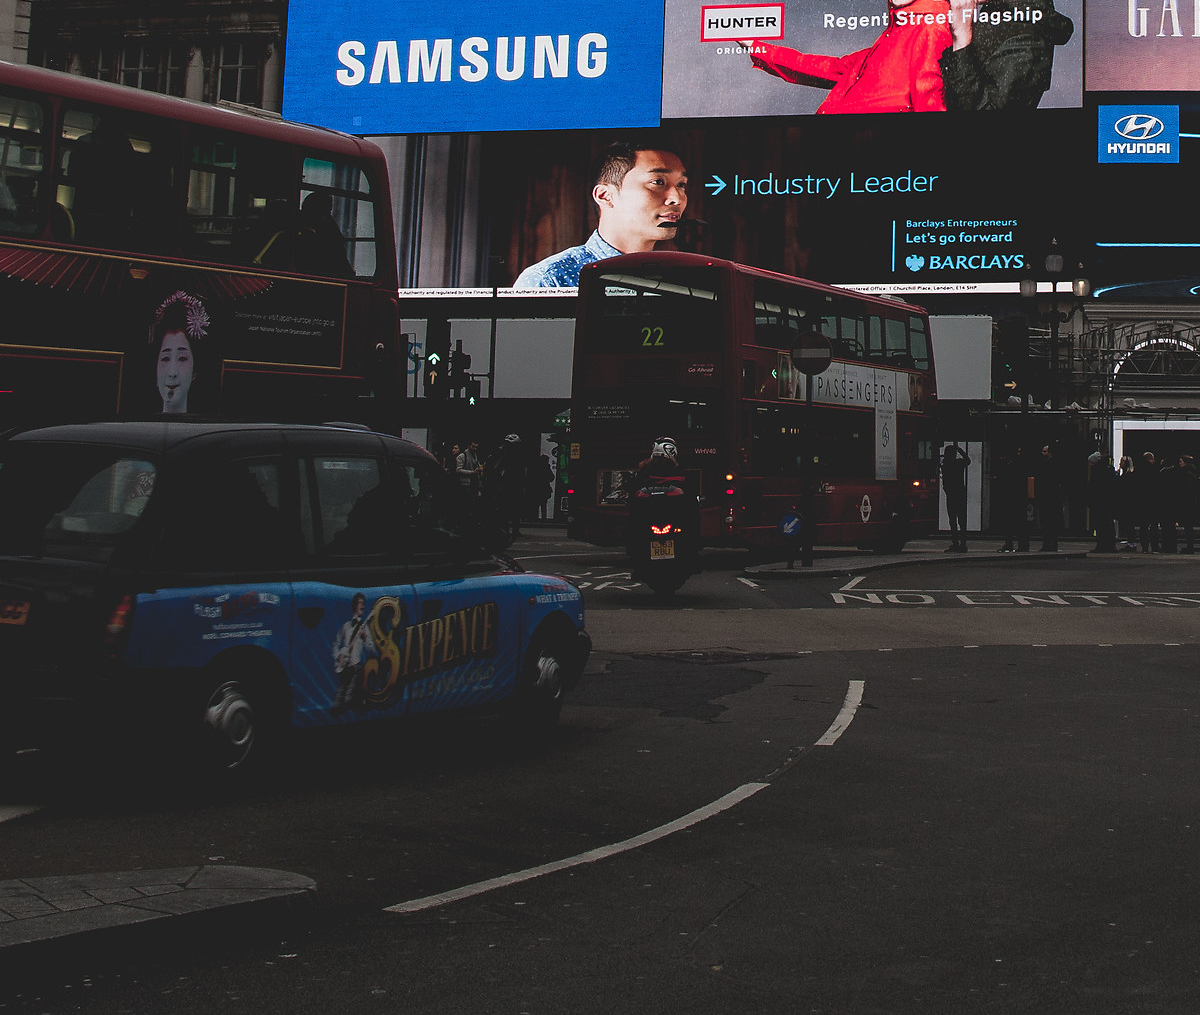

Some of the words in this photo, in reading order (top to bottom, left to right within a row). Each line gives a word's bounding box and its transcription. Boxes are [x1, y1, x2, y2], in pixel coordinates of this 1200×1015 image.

[707, 16, 778, 30] HUNTER
[823, 12, 890, 31] Regent
[895, 9, 954, 27] Street
[961, 6, 1043, 28] Flagship
[716, 46, 768, 56] ORIGINAL
[335, 32, 608, 87] SAMSUNG
[1107, 142, 1171, 154] HYUNDAI
[733, 172, 841, 199] Industry
[849, 169, 939, 194] Leader
[905, 219, 945, 229] Barclays
[946, 218, 1018, 229] Entrepreneurs
[905, 232, 937, 245] Let's
[938, 233, 957, 246] go
[958, 231, 1013, 244] forward
[928, 253, 1025, 270] BARCLAYS
[640, 326, 665, 347] 22
[817, 376, 893, 404] PASSENGERS
[694, 448, 717, 456] WHV40
[830, 592, 936, 605] NO
[362, 595, 497, 704] SIXPENCE
